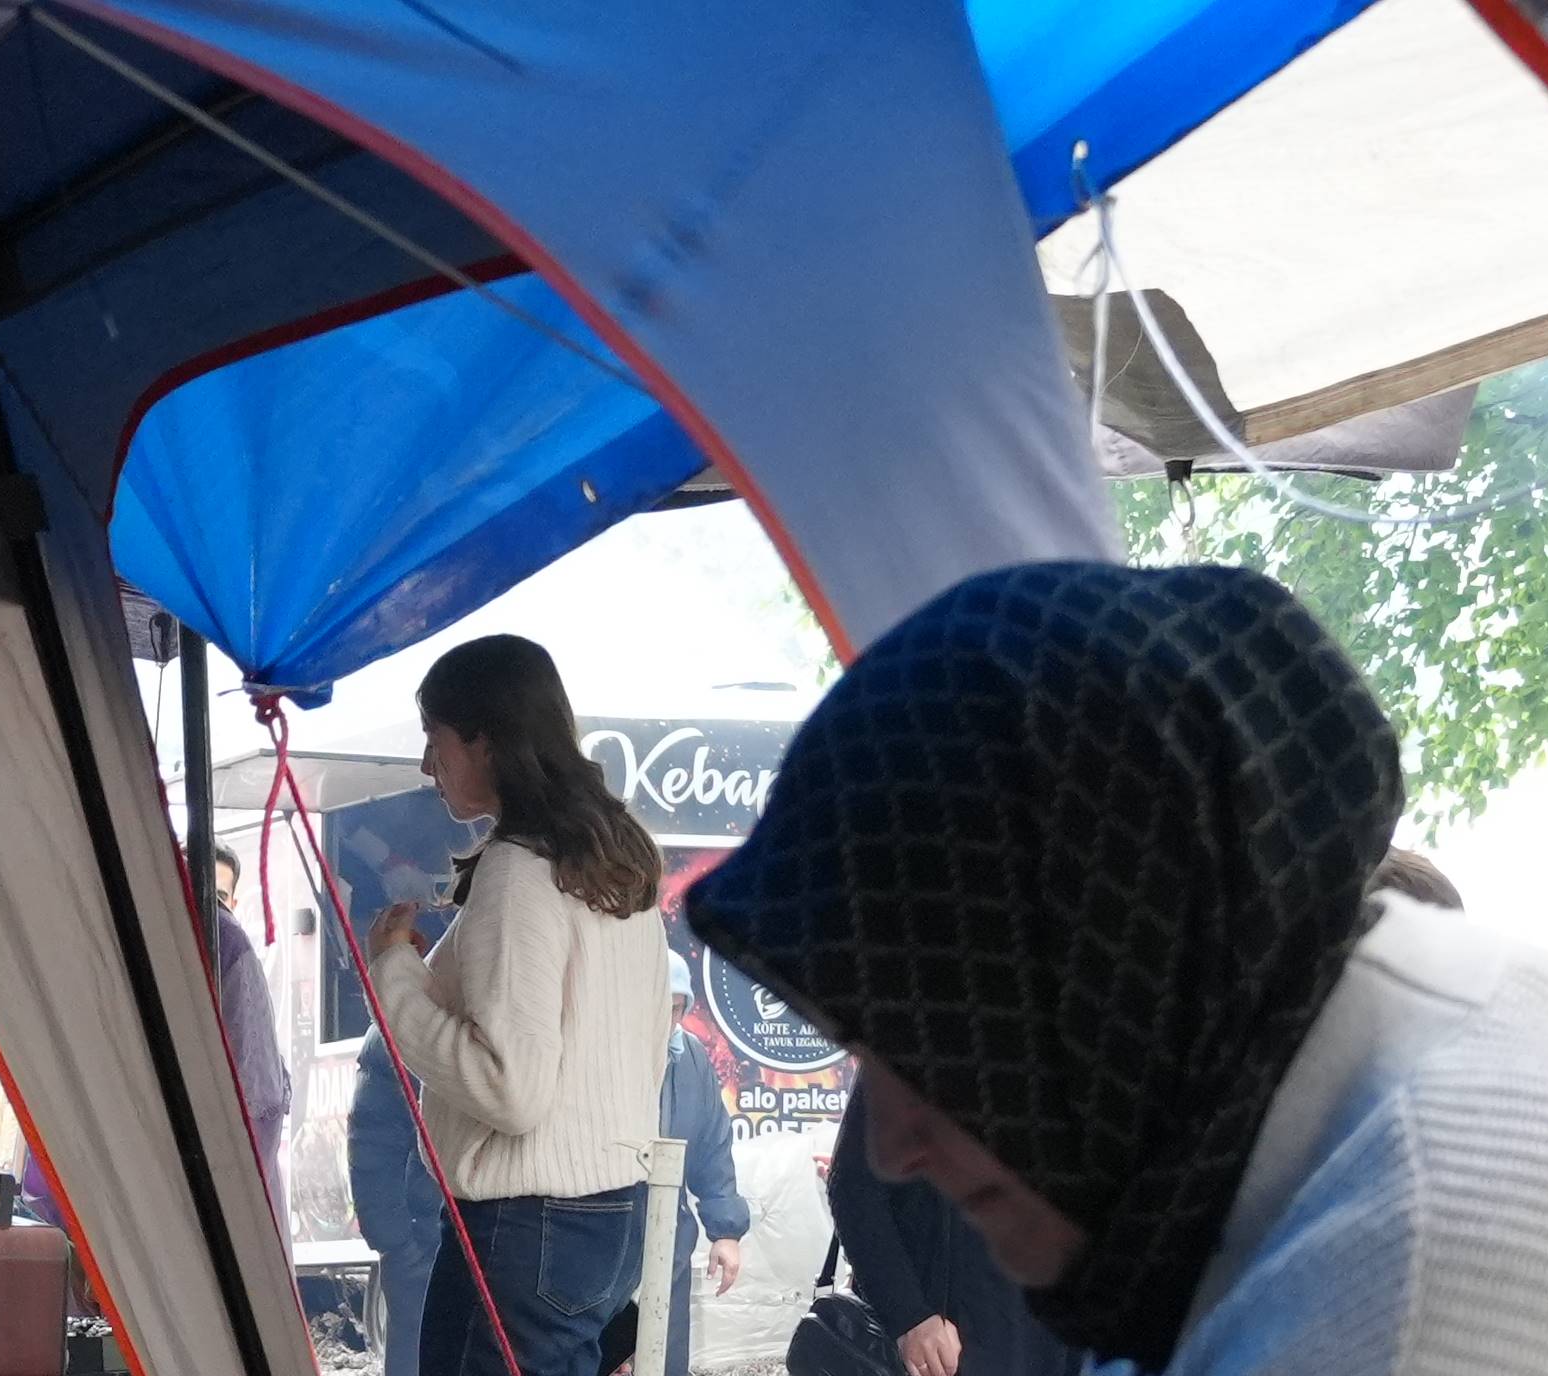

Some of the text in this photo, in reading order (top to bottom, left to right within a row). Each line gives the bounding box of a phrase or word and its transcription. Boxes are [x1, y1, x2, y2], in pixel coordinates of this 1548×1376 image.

[753, 1020, 790, 1035] KÖFTE
[762, 1037, 795, 1047] TAVUK
[739, 1086, 849, 1114] alo paket
